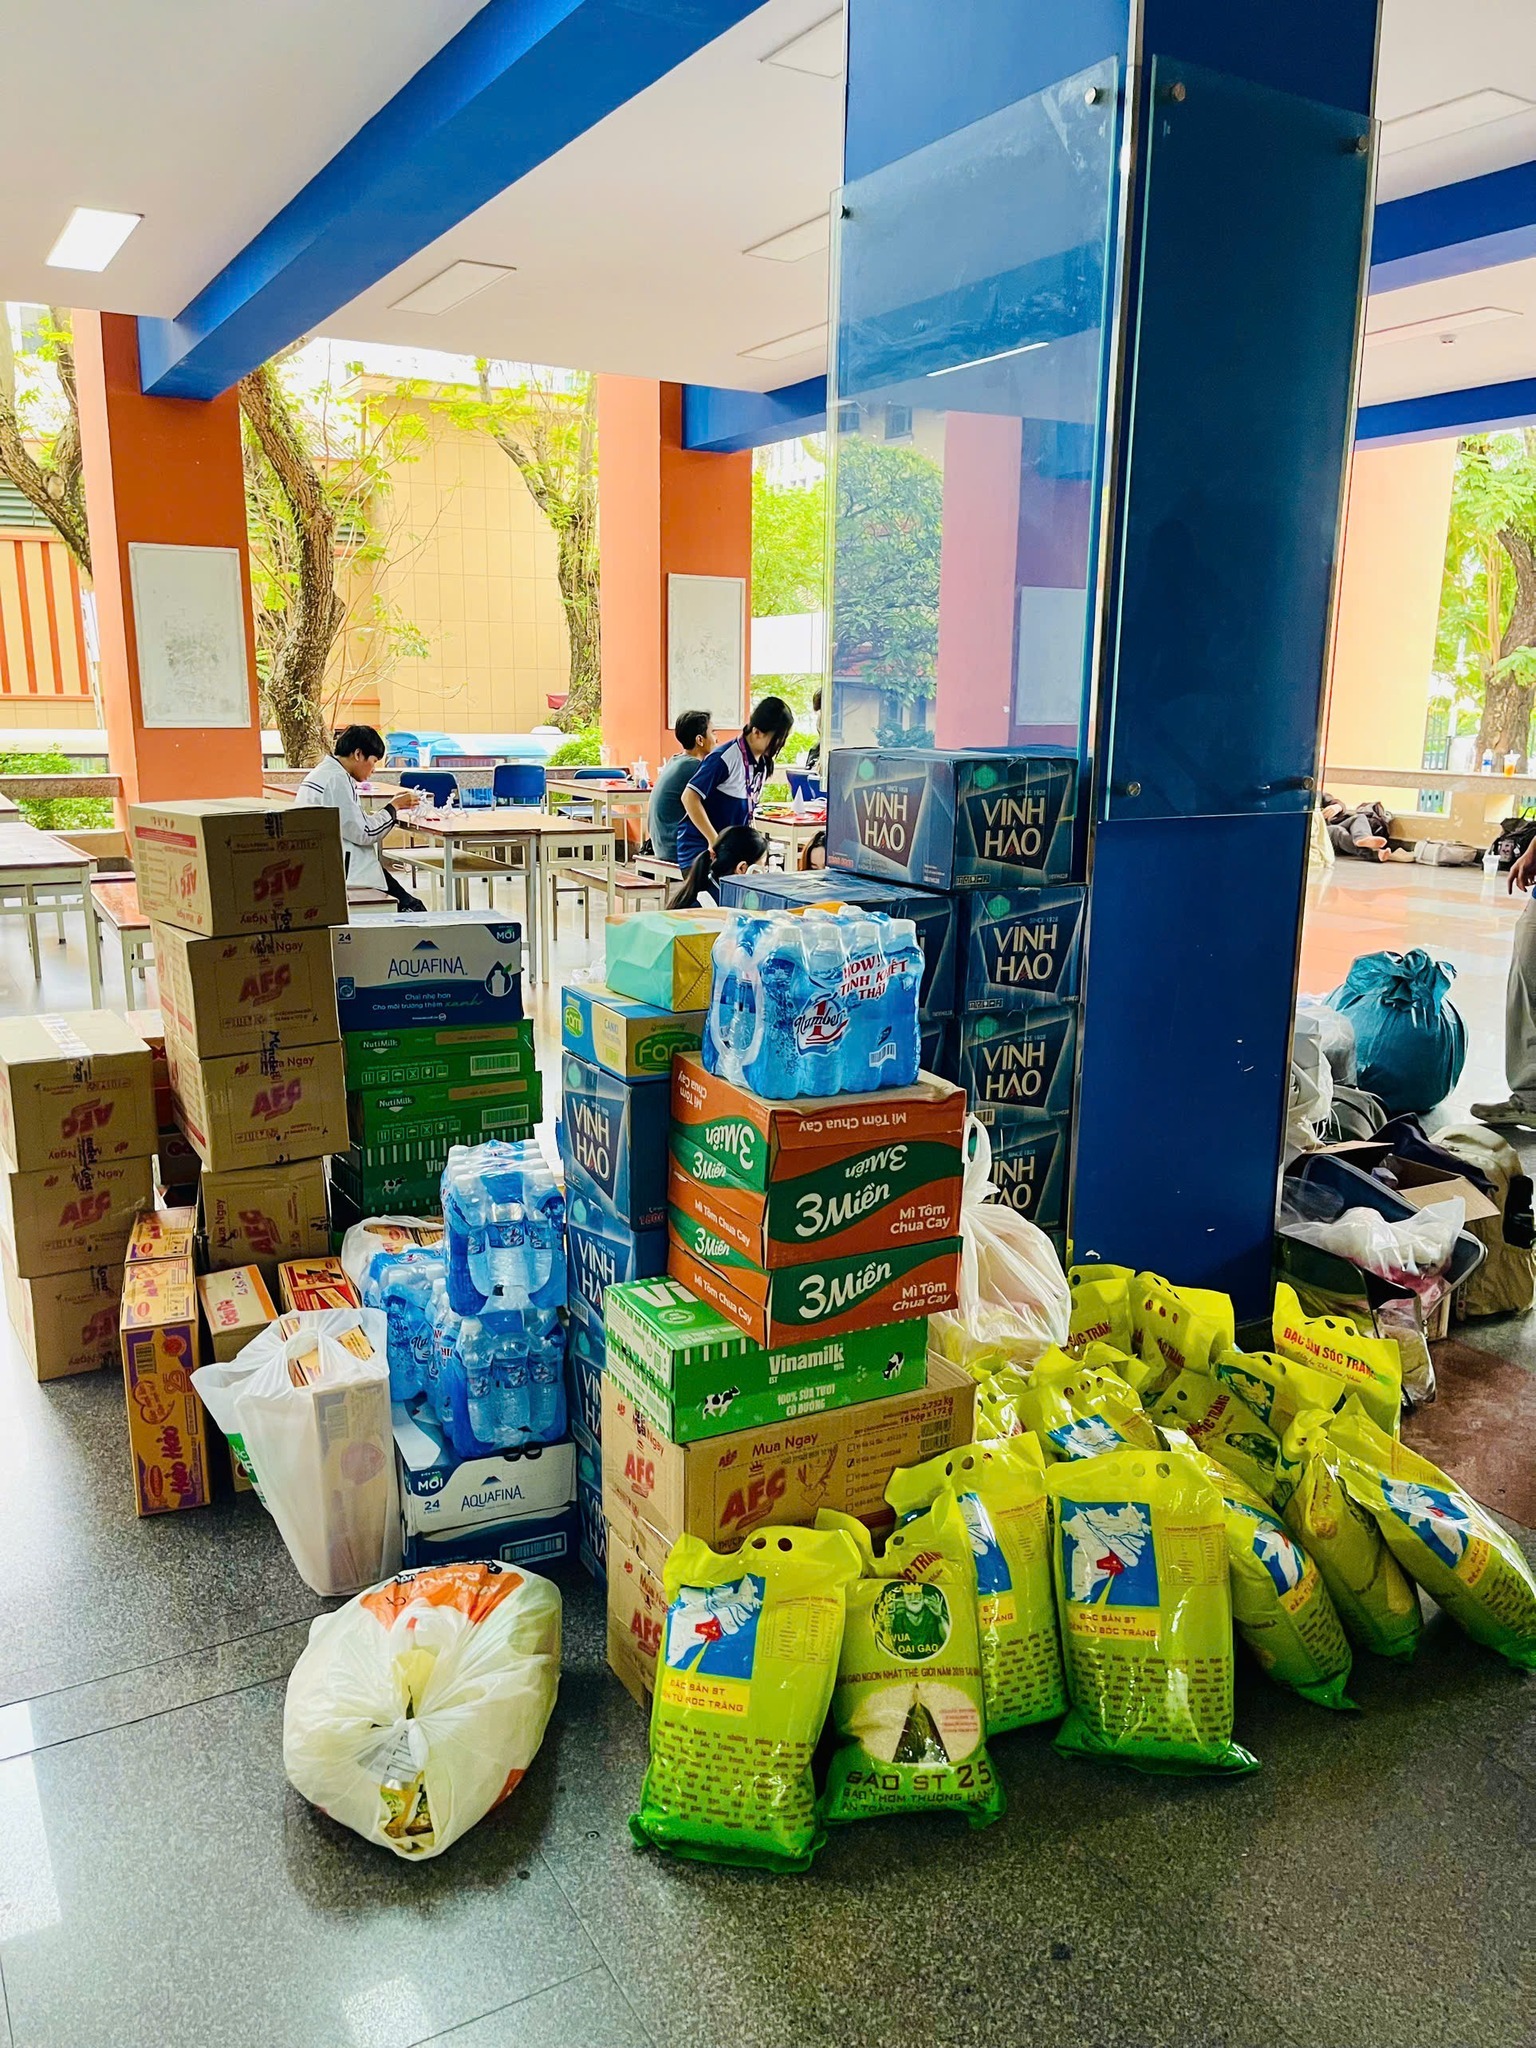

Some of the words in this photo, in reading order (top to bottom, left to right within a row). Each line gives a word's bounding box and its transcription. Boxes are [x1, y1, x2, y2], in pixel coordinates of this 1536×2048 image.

[276, 940, 303, 954] Ngay
[338, 933, 352, 942] 24
[388, 956, 465, 979] AQUAFINA
[287, 1055, 315, 1068] Ngay
[798, 1119, 823, 1132] Cay
[826, 1116, 860, 1130] Chua
[992, 1155, 1035, 1184] ĨNH
[899, 1207, 916, 1220] Mì
[916, 1204, 946, 1218] Tôm
[890, 1219, 925, 1235] Chua
[925, 1215, 951, 1232] Cay
[901, 1284, 920, 1300] Mì
[919, 1281, 948, 1297] Tôm
[718, 1289, 738, 1312] Chua
[736, 1303, 753, 1325] Cay
[892, 1295, 925, 1312] Chua
[925, 1292, 952, 1307] Cay
[769, 1343, 845, 1376] Vinamilk
[1322, 1346, 1344, 1365] SÓC
[943, 1396, 954, 1407] kg
[752, 1442, 781, 1458] Mua
[785, 1433, 819, 1449] Ngay
[424, 1499, 440, 1511] 24
[461, 1485, 522, 1512] AQUAFINA
[719, 1466, 786, 1529] AFC
[913, 1774, 947, 1791] ST
[957, 1760, 992, 1789] 25
